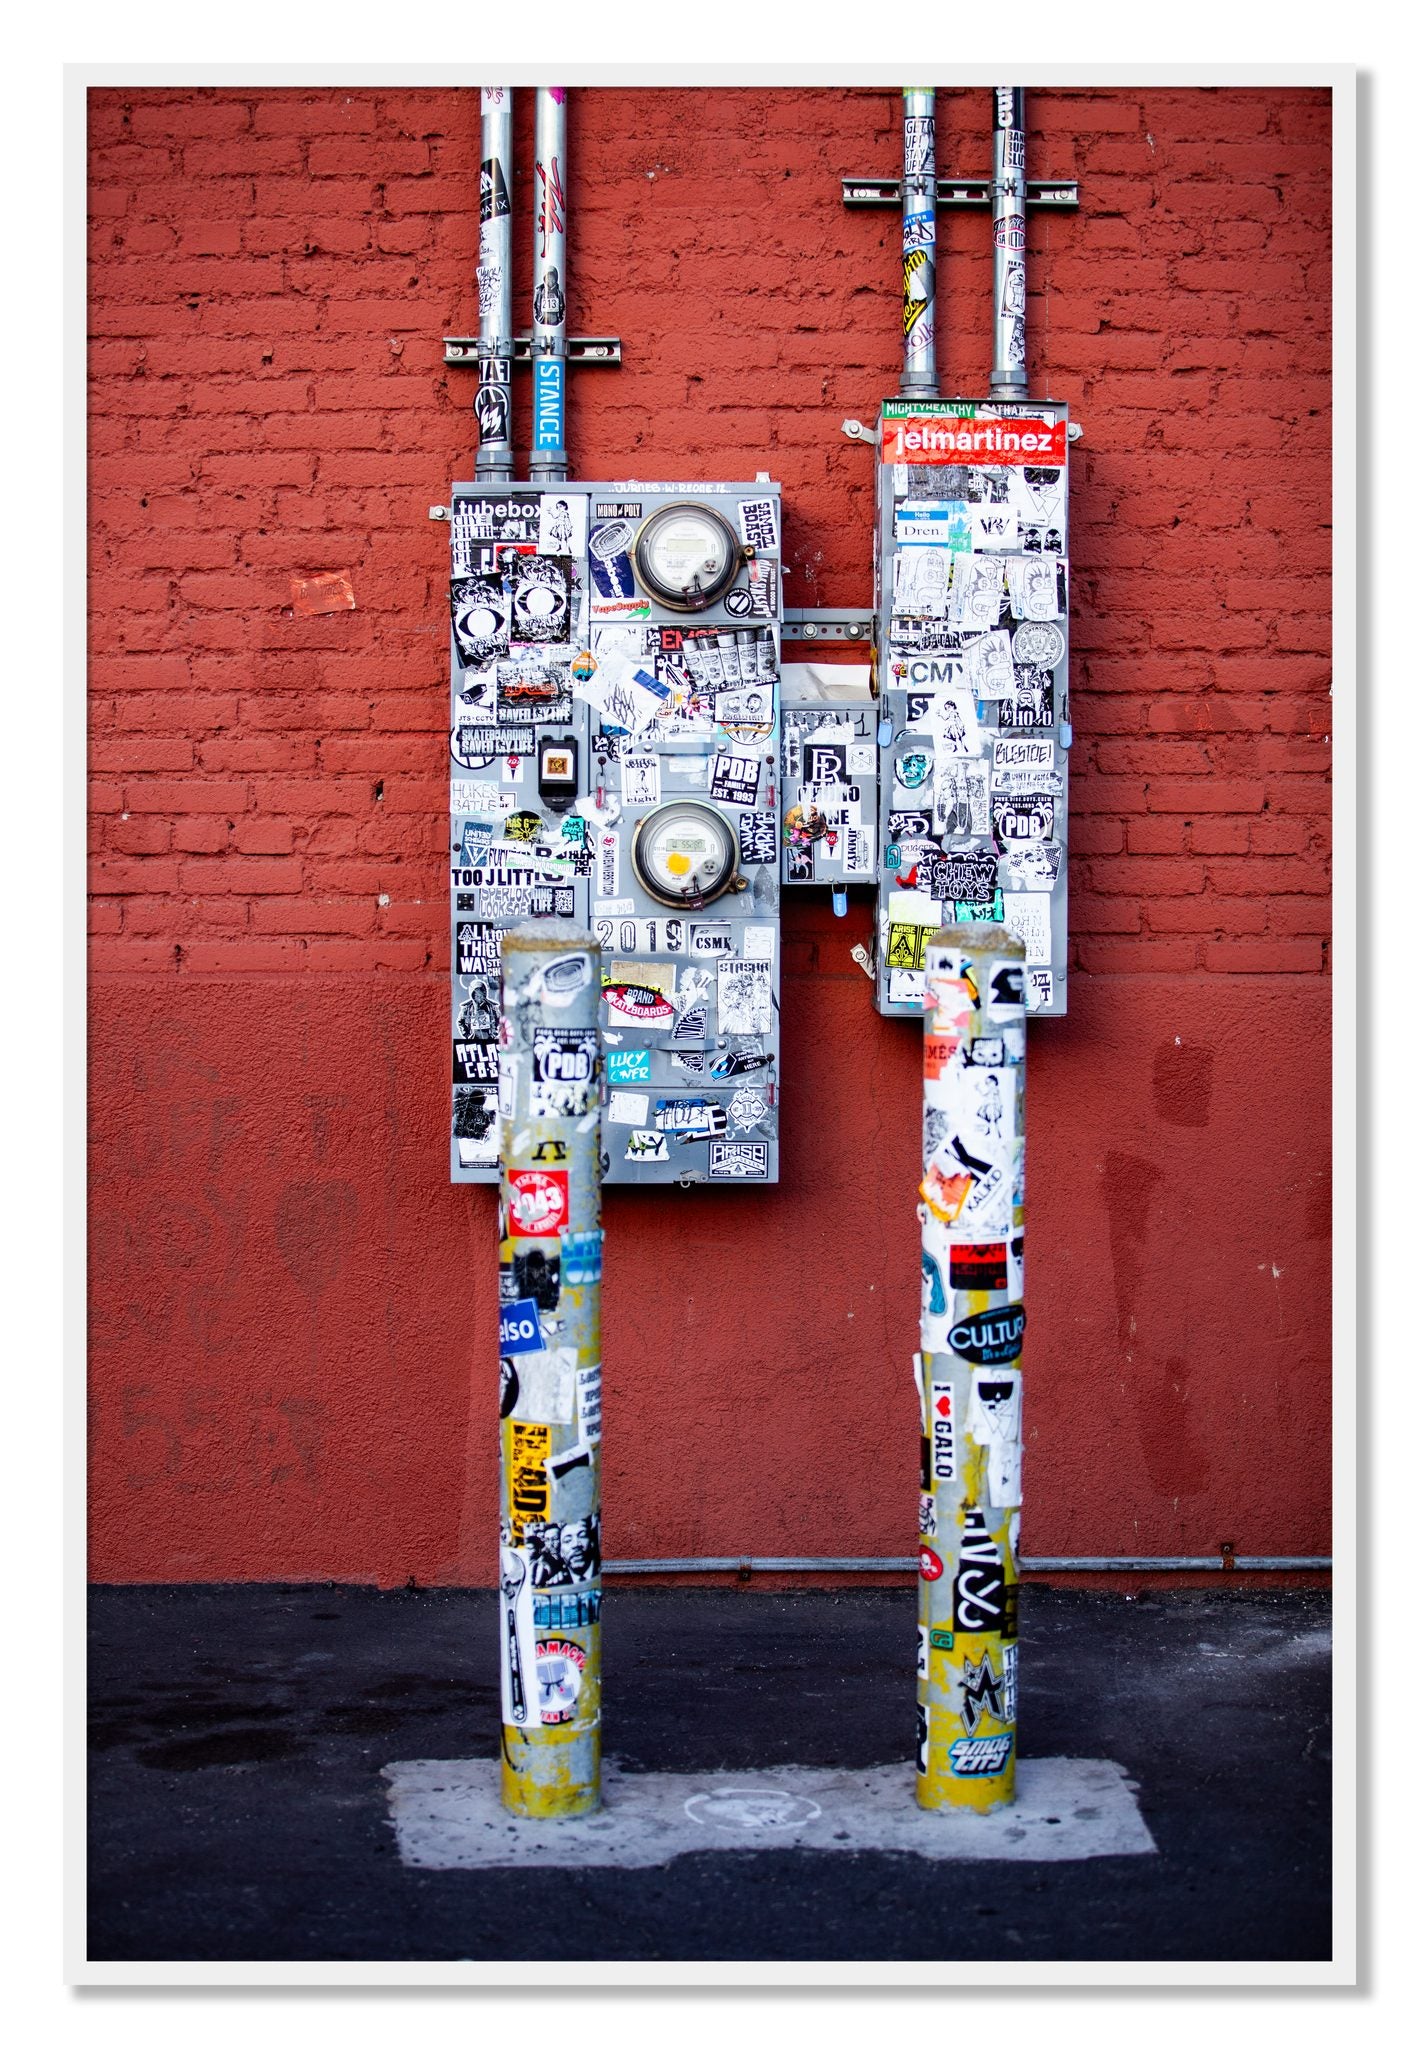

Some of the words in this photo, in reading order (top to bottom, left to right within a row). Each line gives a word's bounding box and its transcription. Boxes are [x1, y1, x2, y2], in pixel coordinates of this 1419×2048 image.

[539, 364, 560, 446] STANCE
[886, 403, 973, 417] MIGHTYHEALTHY
[896, 427, 1052, 455] jelmartinez
[623, 504, 641, 517] POLY
[453, 515, 478, 526] CITY
[743, 504, 763, 550] BOAST
[454, 526, 493, 538] FILTH
[904, 525, 944, 536] Dren.
[461, 729, 533, 742] SKATEBOARDING
[461, 741, 494, 754] SAVED
[717, 756, 759, 784] PDB
[724, 780, 746, 791] FAMILY
[712, 787, 730, 798] EST.
[732, 790, 755, 803] 1993
[1005, 815, 1042, 837] PDB
[451, 868, 483, 886] TOO
[933, 861, 995, 883] CHEW
[935, 881, 990, 900] TOYS
[597, 919, 682, 953] 2019
[892, 925, 916, 934] ARISE
[696, 937, 733, 949] CSMK
[549, 1052, 588, 1080] PDB
[610, 1052, 643, 1068] LUCY
[713, 1144, 765, 1163] ARISE
[934, 1420, 953, 1480] GALO
